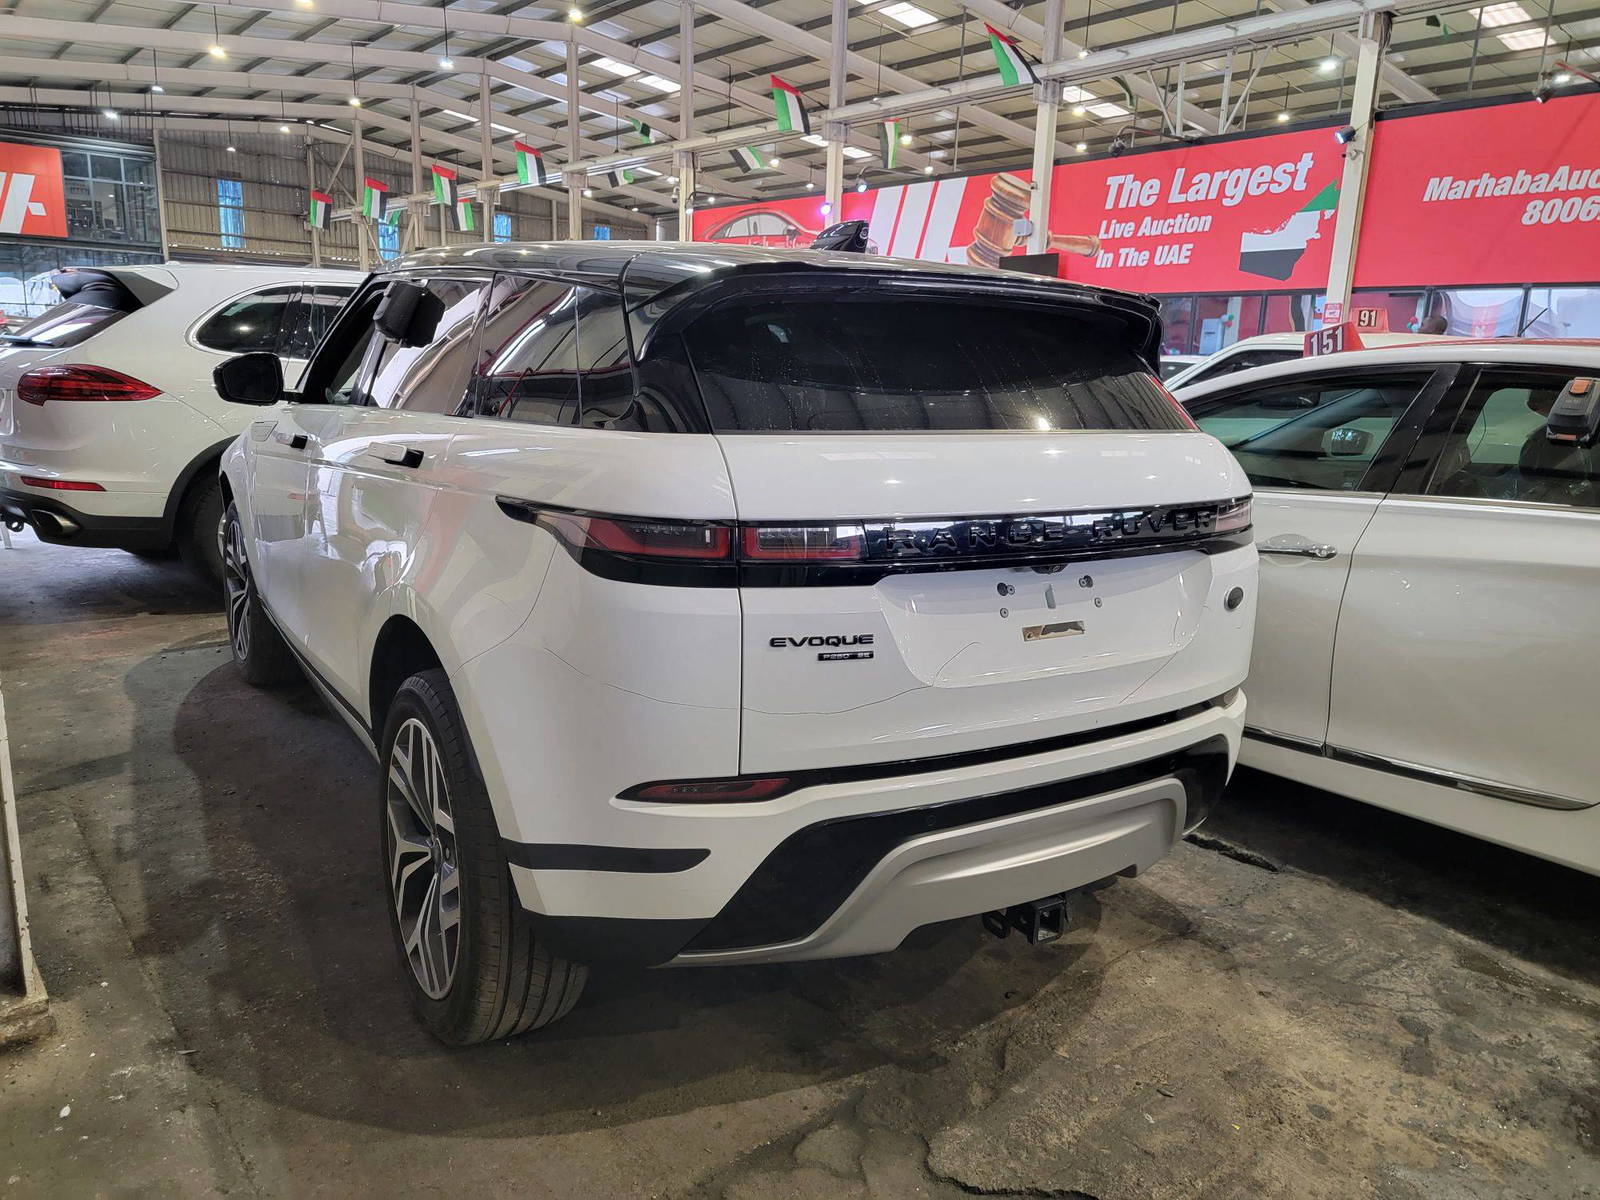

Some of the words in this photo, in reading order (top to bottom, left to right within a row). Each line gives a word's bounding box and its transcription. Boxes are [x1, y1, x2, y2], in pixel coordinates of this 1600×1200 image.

[1105, 174, 1161, 210] The
[1168, 152, 1314, 207] Largest
[1099, 219, 1139, 240] Live
[1137, 212, 1213, 237] Auction
[1095, 249, 1114, 269] In
[1117, 247, 1150, 268] The
[1153, 243, 1194, 266] UAE
[1359, 309, 1377, 327] 91
[1310, 325, 1343, 356] 151
[881, 517, 1064, 554] RANGE
[1092, 508, 1211, 538] ROVER
[769, 634, 874, 648] EVOQUE
